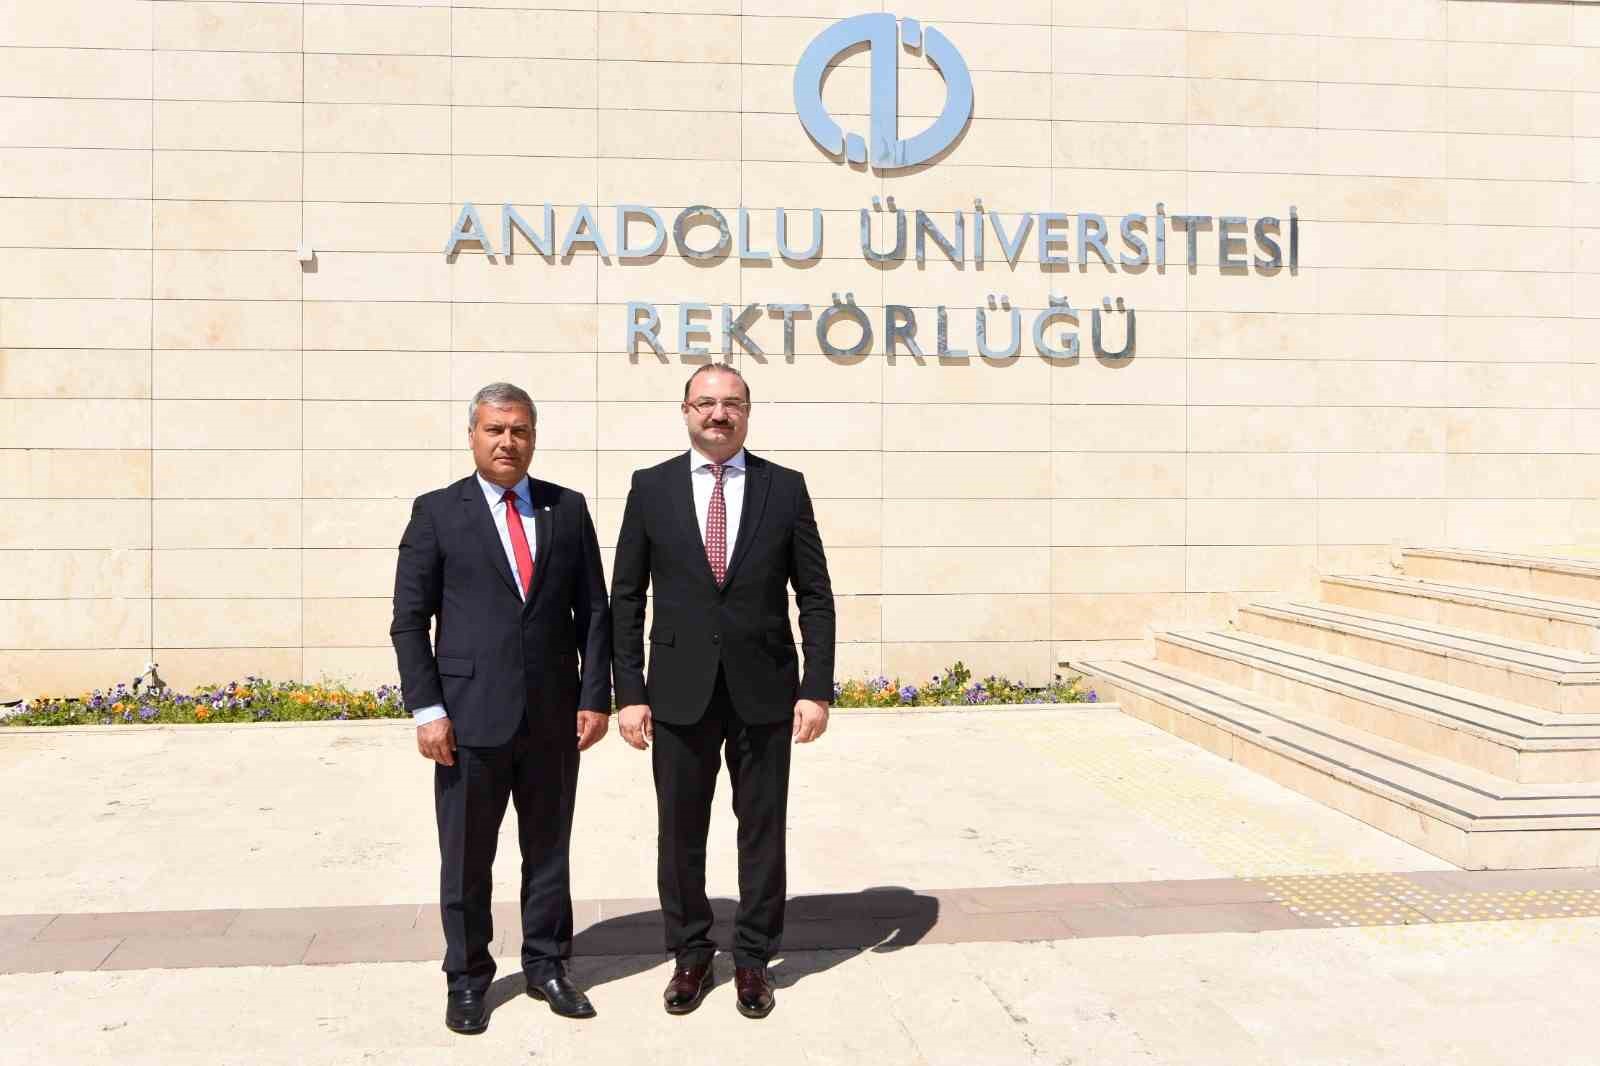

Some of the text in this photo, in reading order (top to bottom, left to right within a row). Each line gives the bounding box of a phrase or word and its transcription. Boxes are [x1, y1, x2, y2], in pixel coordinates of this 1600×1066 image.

[444, 196, 1299, 270] ANADOLU ÜNİVERSİTESİ
[626, 290, 1136, 361] REKTÖRLÜĞÜ
